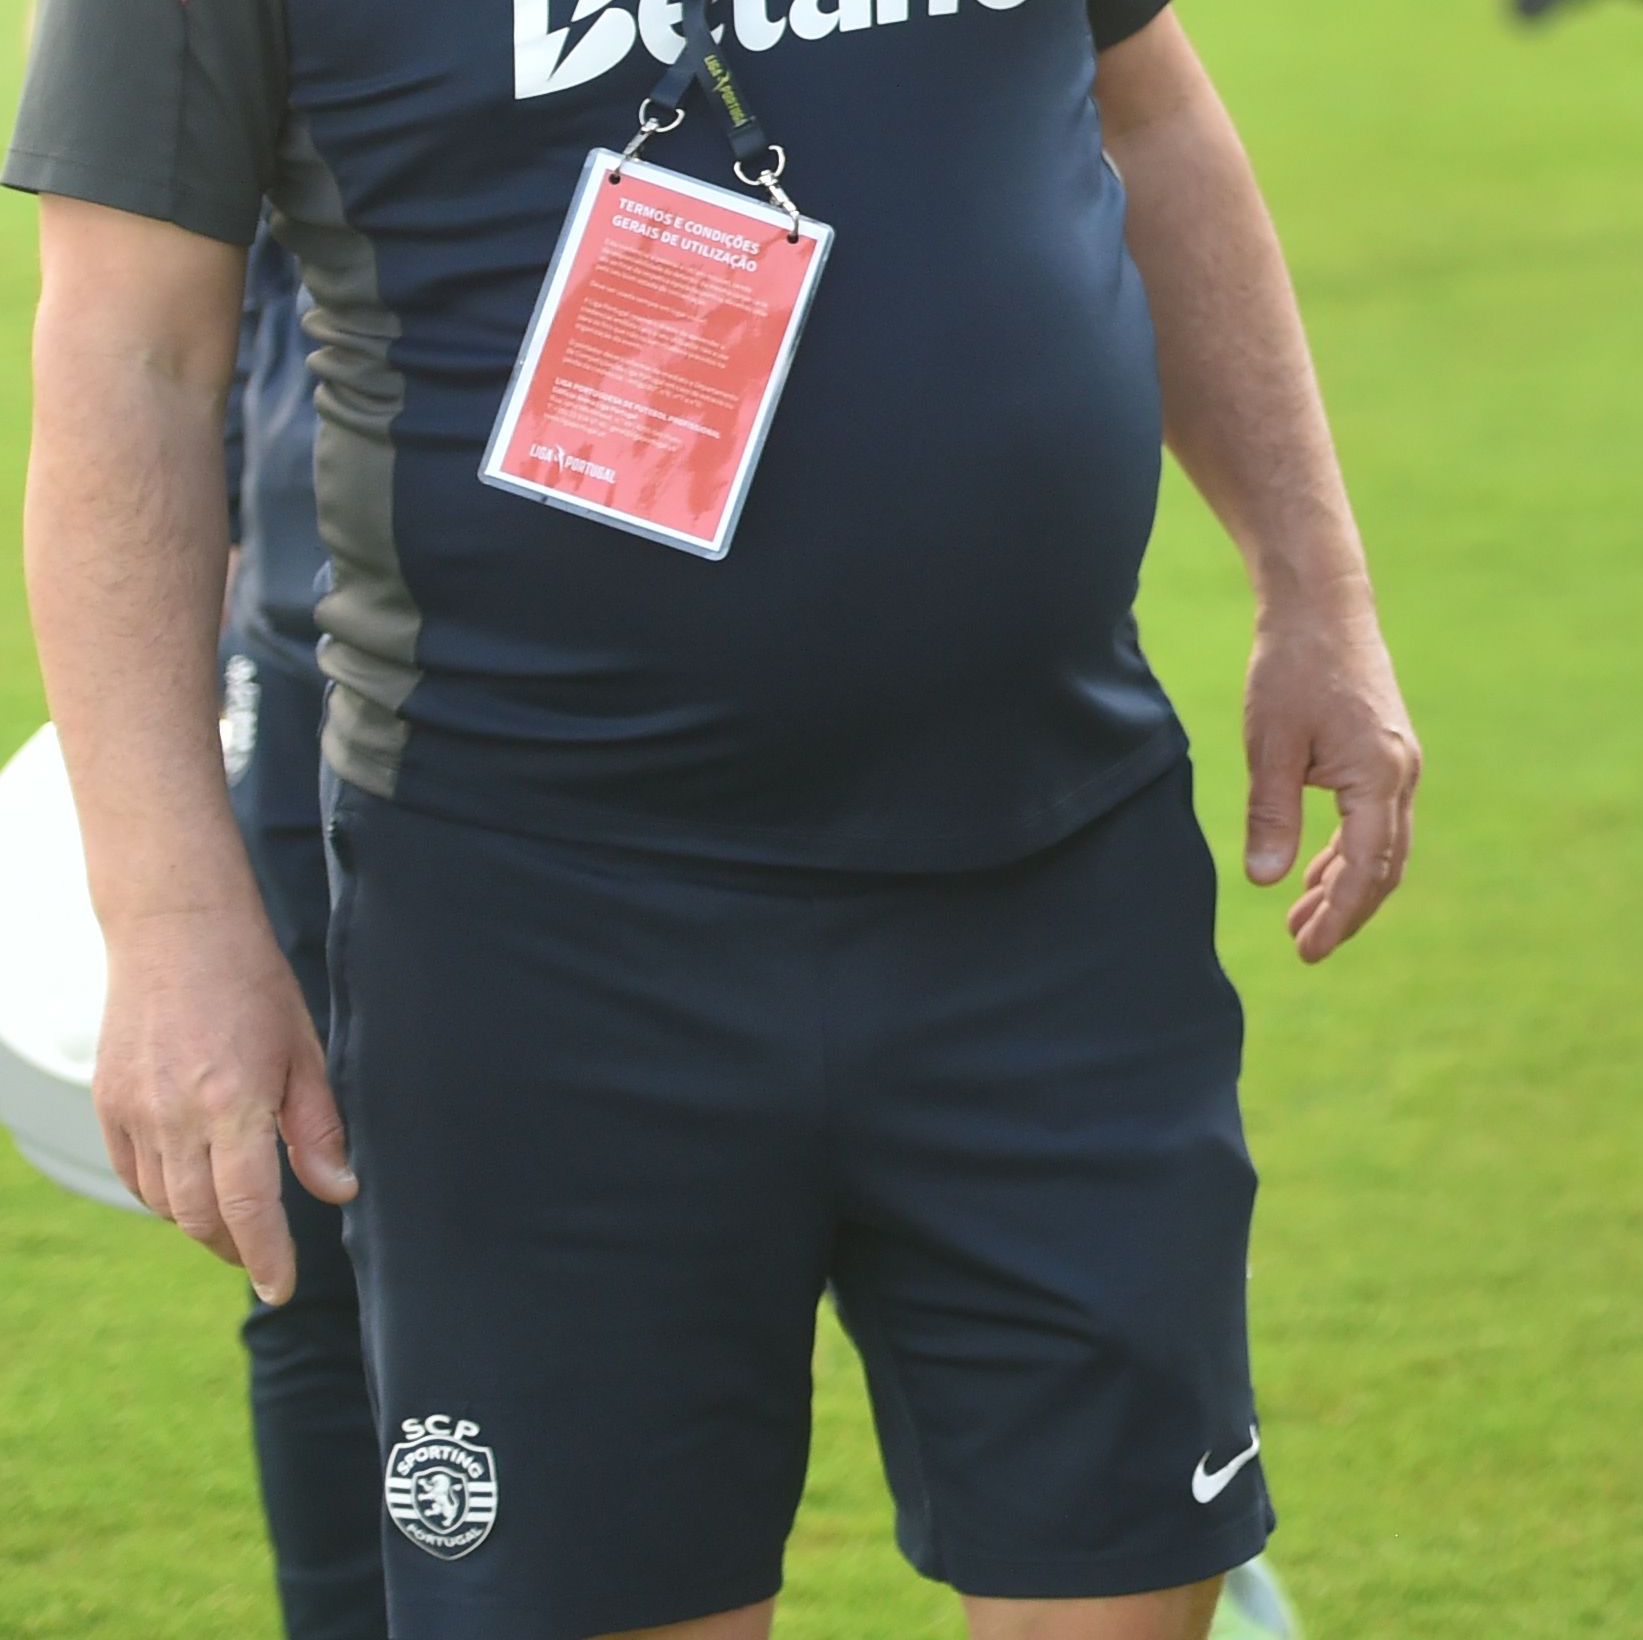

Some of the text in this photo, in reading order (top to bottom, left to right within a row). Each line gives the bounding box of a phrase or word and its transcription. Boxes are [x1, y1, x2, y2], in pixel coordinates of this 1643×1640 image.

[703, 52, 724, 78] LIGA
[619, 198, 672, 225] TERMOS
[673, 217, 684, 228] E
[684, 221, 760, 255] CONDIÇÕES
[612, 215, 659, 239] GERAIS
[661, 231, 678, 246] DE
[681, 238, 757, 272] UTILIZAÇÃO
[554, 376, 573, 389] LIGA
[528, 442, 618, 484] LIGA PORTUGAL
[401, 1414, 480, 1440] SCP
[397, 1445, 485, 1479] SPORTING
[405, 1523, 483, 1547] PORTUGAL
